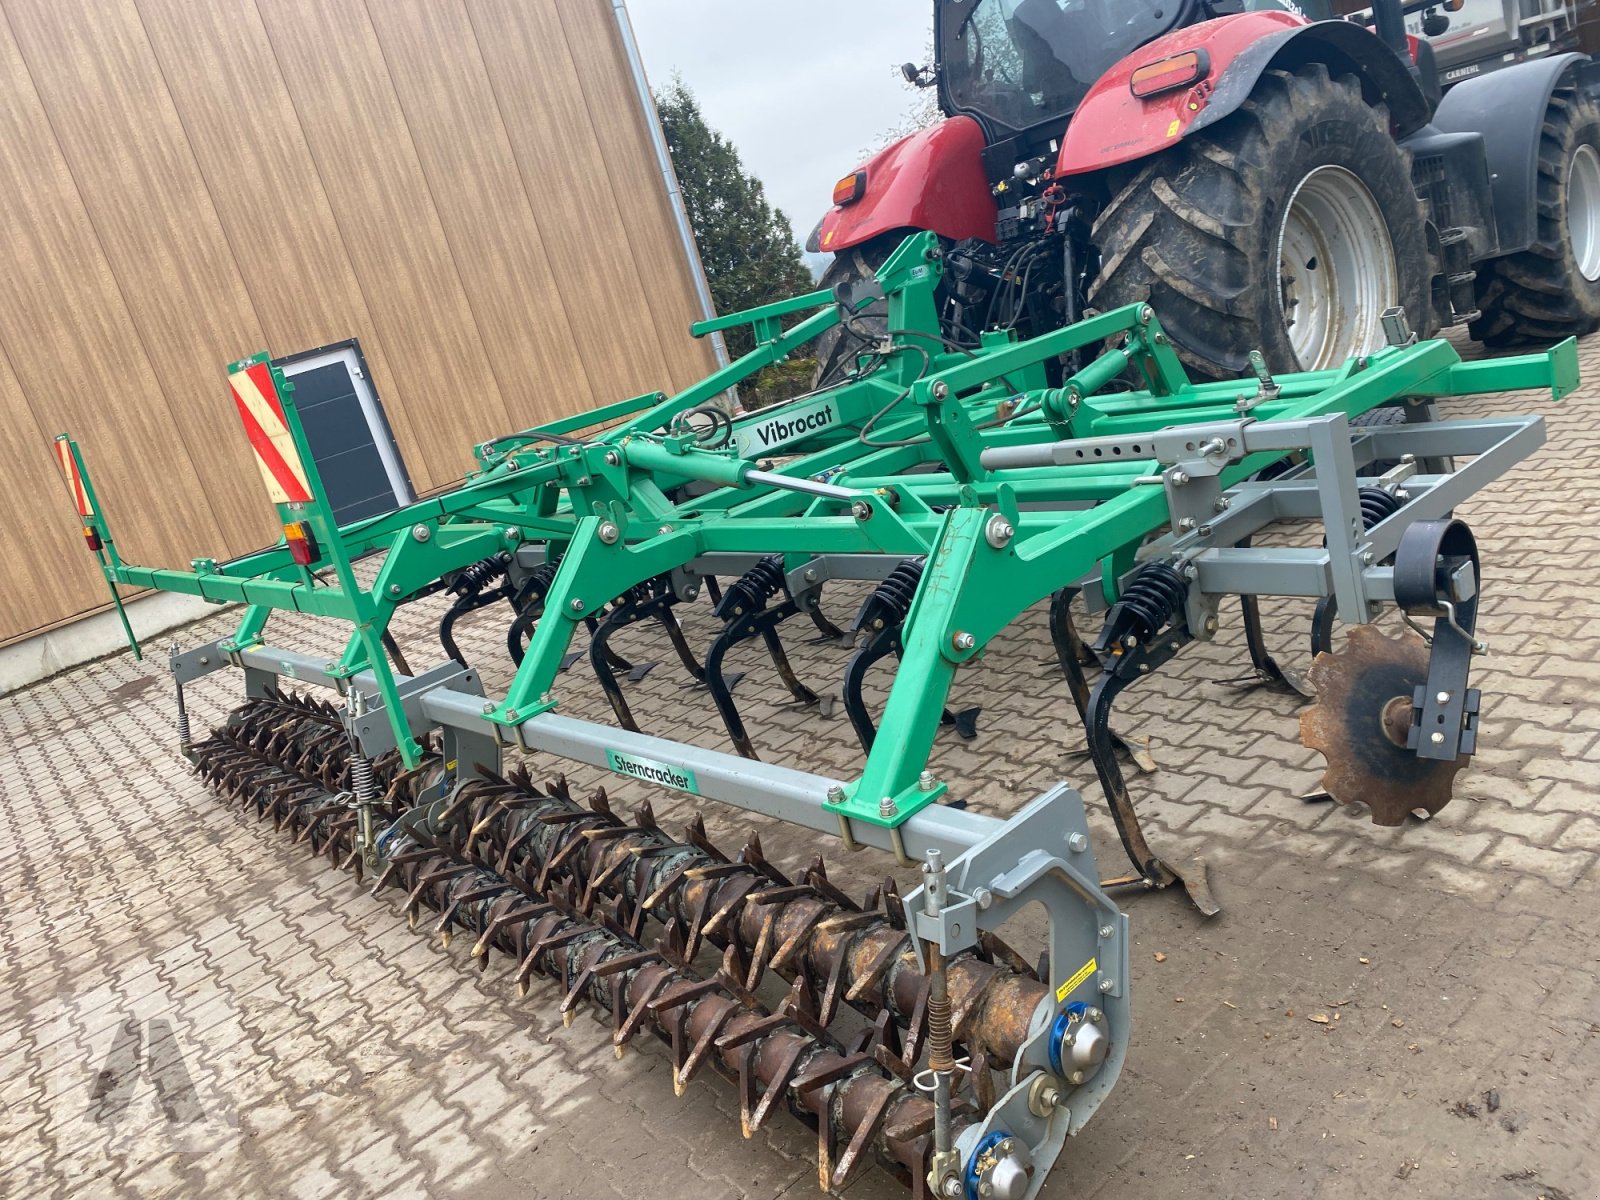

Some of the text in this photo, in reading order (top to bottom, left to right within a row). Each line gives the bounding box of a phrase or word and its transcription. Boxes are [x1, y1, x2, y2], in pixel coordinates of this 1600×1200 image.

[1446, 65, 1480, 80] CARNEHL
[757, 404, 833, 446] Vibrocat
[614, 754, 689, 789] Sterncracker
